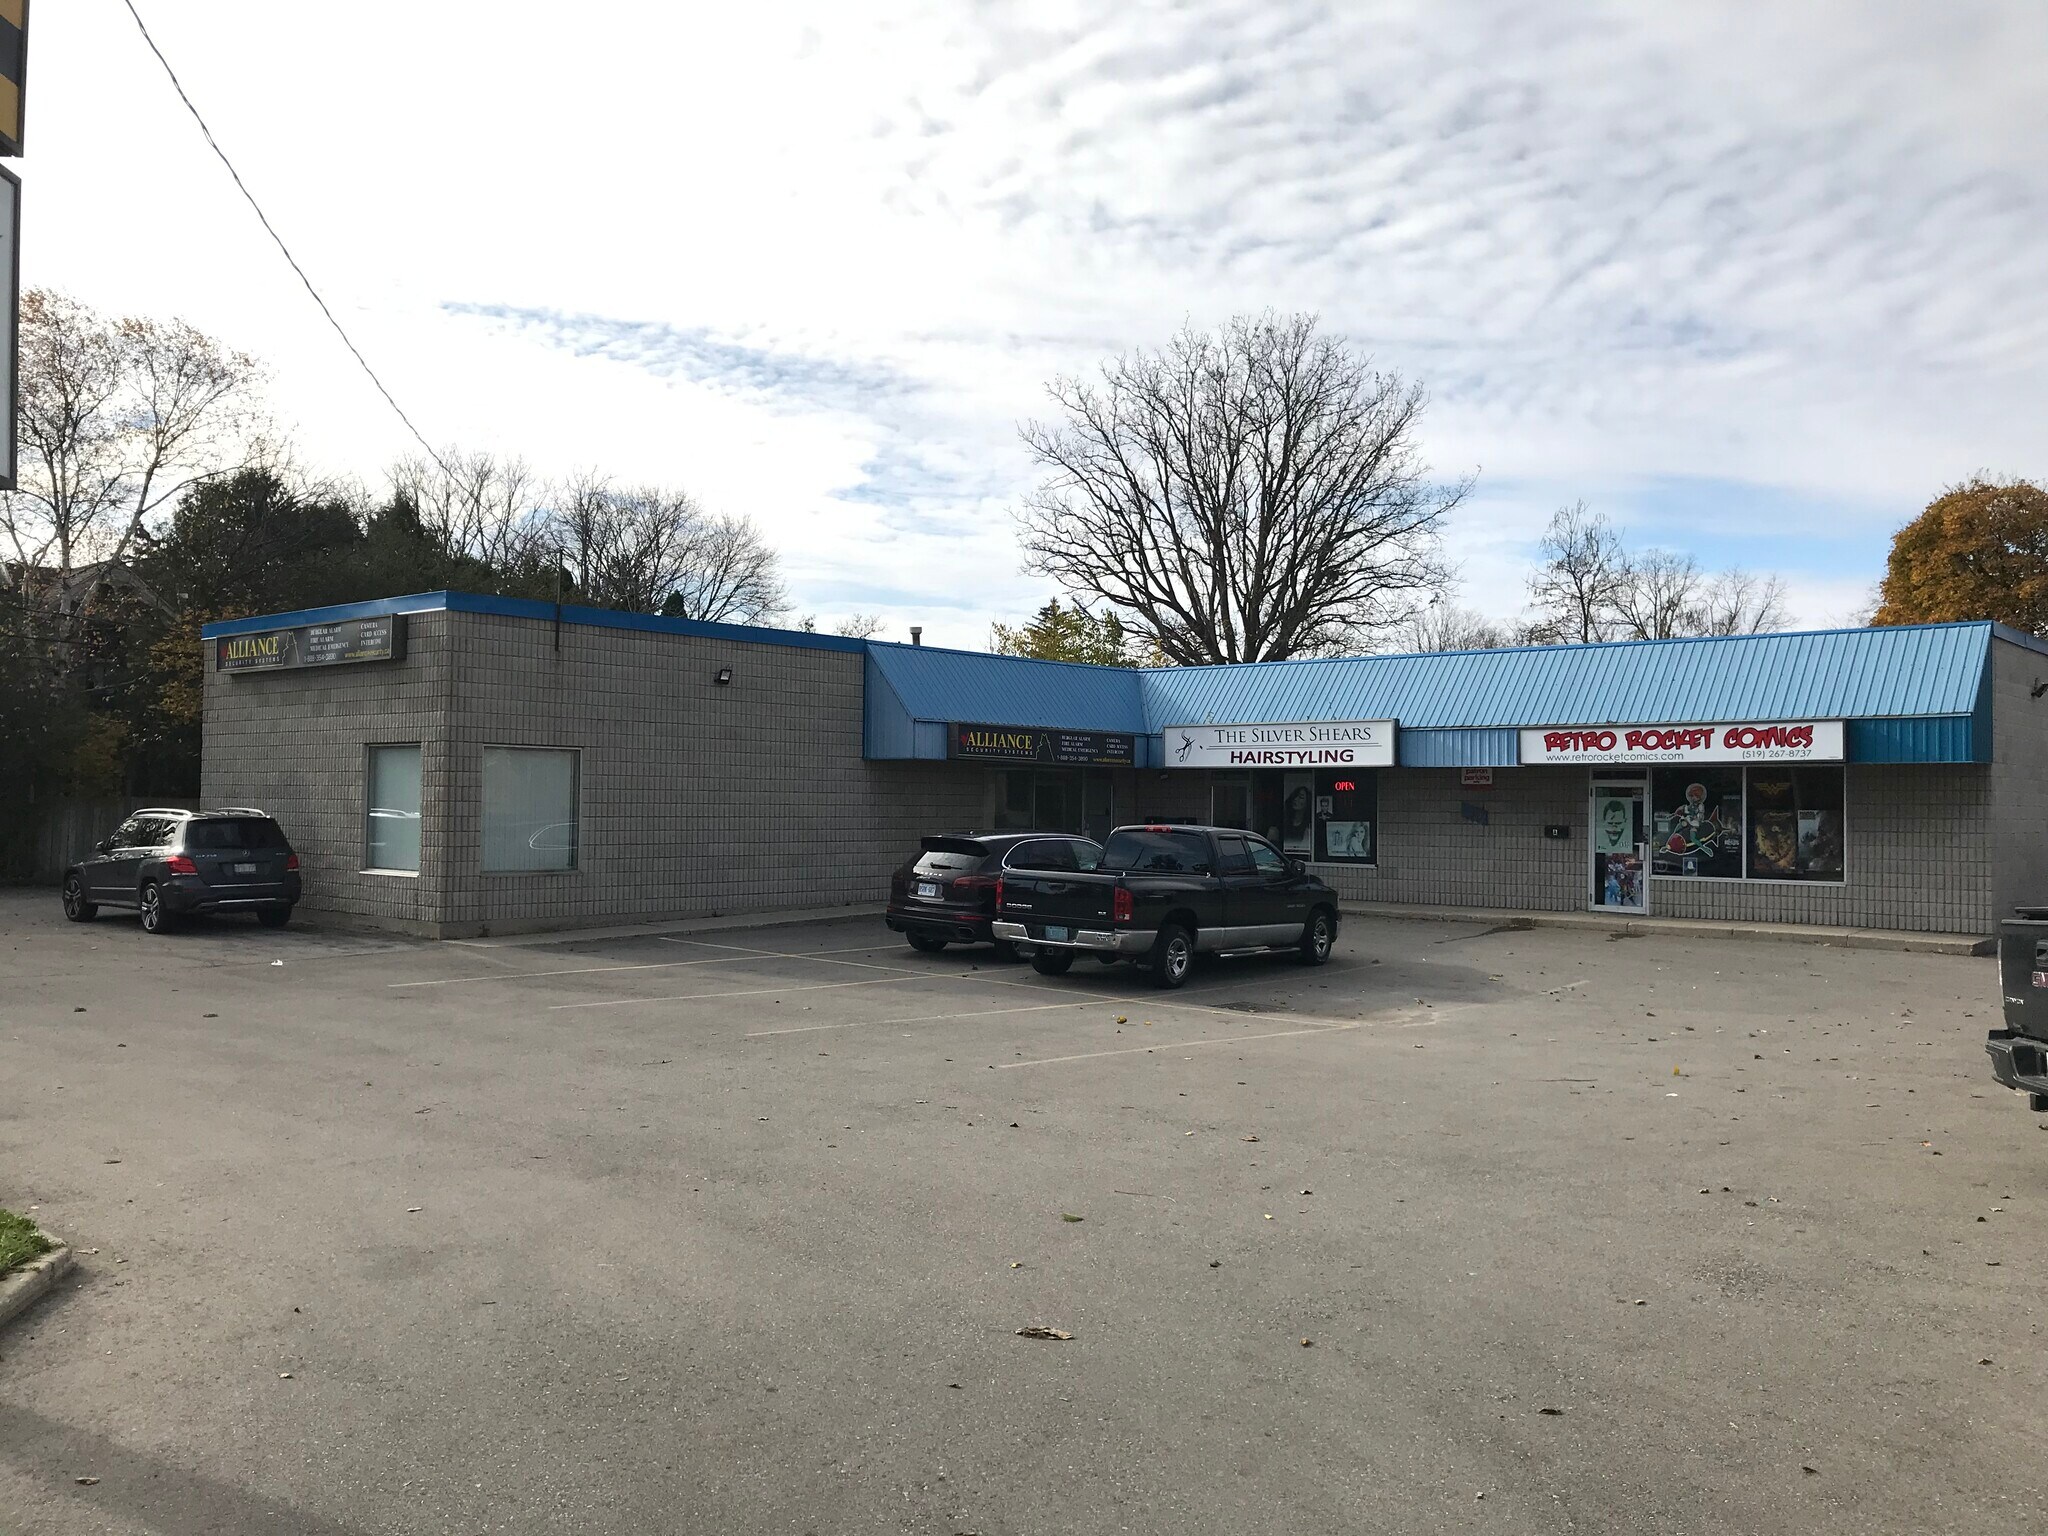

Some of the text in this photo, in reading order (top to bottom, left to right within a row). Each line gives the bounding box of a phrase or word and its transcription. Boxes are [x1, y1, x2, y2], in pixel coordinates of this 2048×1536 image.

[226, 636, 279, 660] ALLIANCE
[225, 656, 280, 667] SECURITY SYSTEMS
[966, 731, 1033, 750] ALLIANCE
[1214, 726, 1372, 743] THE SILVER SHEARS
[1543, 725, 1814, 752] RETRO ROCKET COMICS
[1230, 749, 1354, 764] HAIRSTYLING
[1546, 752, 1684, 762] www.retrorocketcomics.com
[1742, 750, 1812, 760] (519) 267-8737
[1335, 781, 1355, 791] OPEN
